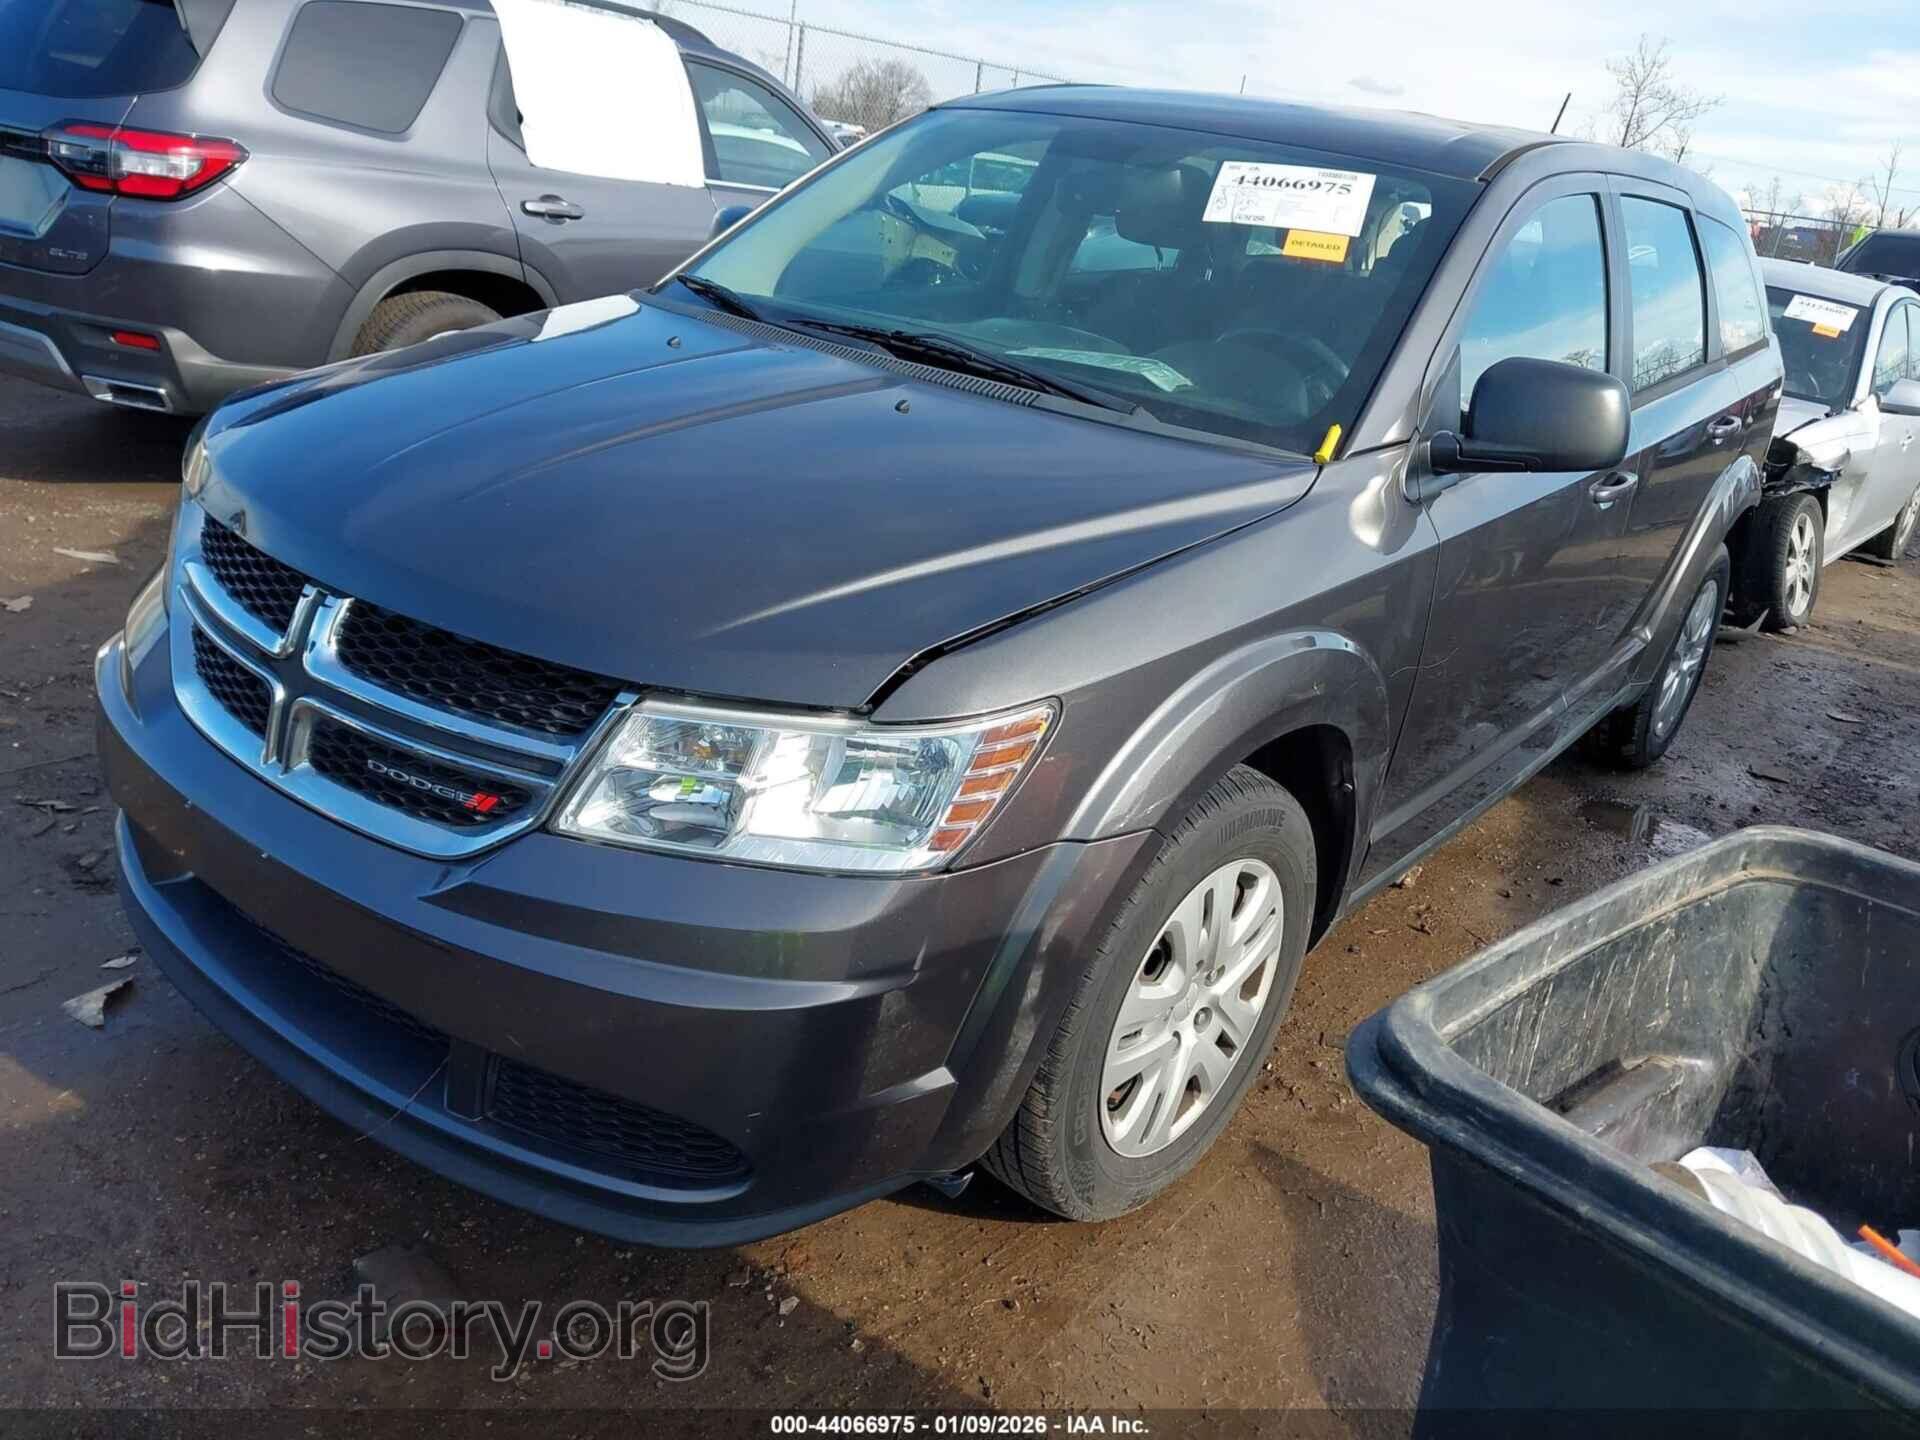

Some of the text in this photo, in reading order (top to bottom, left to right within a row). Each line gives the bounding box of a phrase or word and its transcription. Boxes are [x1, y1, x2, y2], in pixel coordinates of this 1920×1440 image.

[1232, 174, 1353, 196] 44066975
[1290, 239, 1342, 252] DETAILED
[367, 759, 478, 806] DODGE
